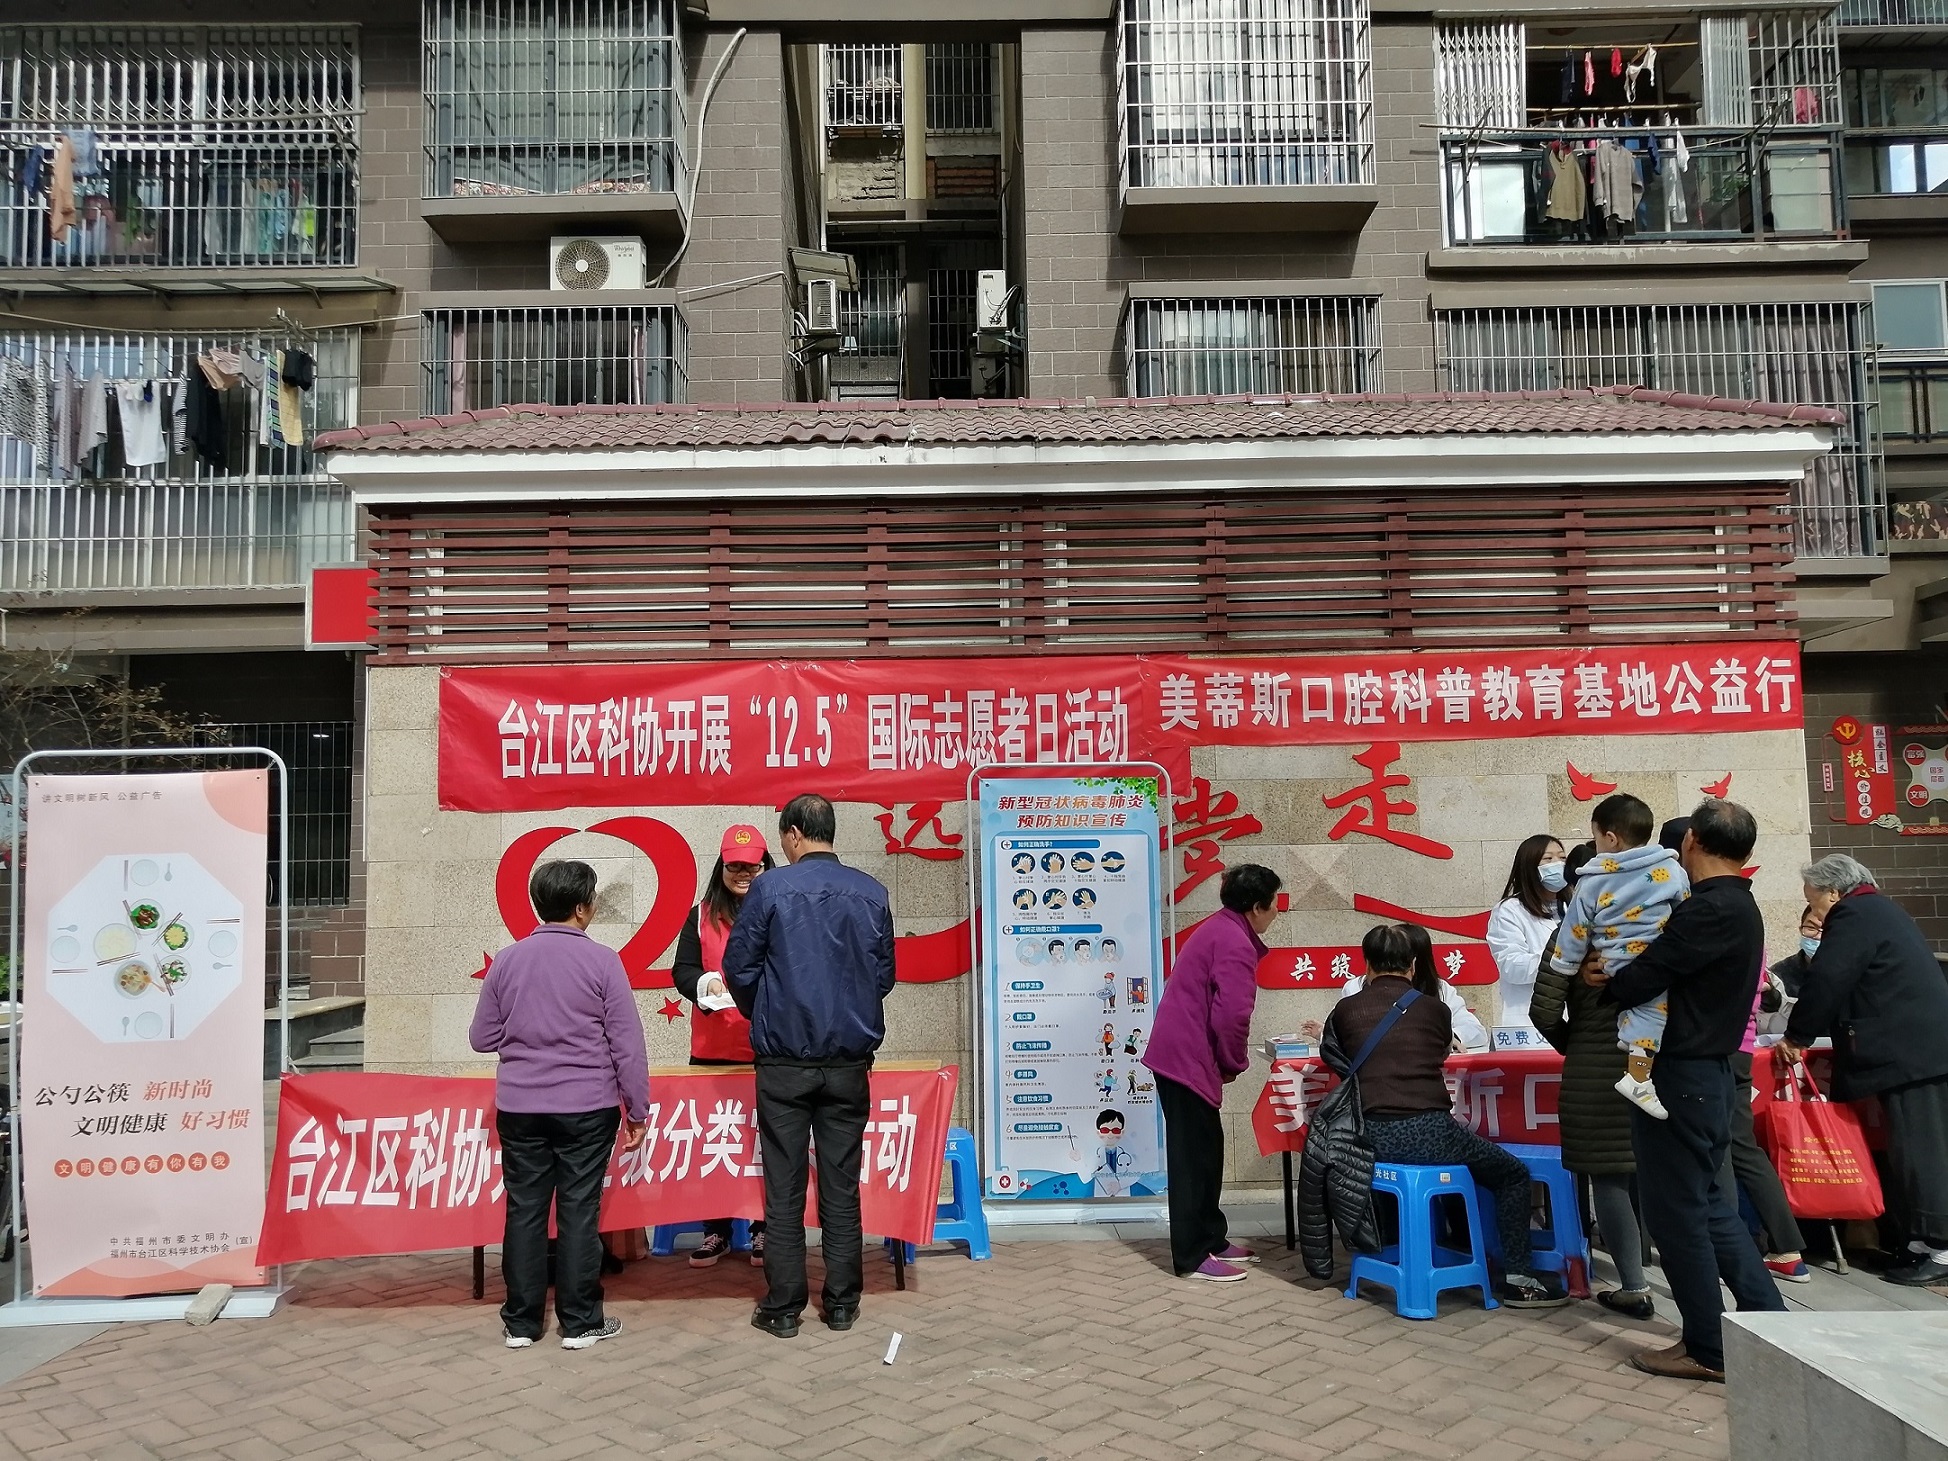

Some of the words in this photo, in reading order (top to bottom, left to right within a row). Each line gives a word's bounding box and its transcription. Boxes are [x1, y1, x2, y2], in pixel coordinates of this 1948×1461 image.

[1159, 656, 1796, 731] 美蒂斯口腔科普教育基地公益行
[118, 791, 163, 801] 公益广告
[998, 795, 1144, 810] 新型冠状病毒肺炎
[1910, 790, 1928, 799] 文明
[1016, 813, 1127, 828] 预防知识宣传
[1290, 950, 1466, 981] 共筑梦
[34, 1082, 131, 1107] 公勺公筷
[143, 1079, 213, 1102] 新时尚
[1267, 1062, 1563, 1137] 美斯口
[71, 1112, 168, 1138] 文明健康
[179, 1108, 251, 1132] 好习惯
[57, 1153, 228, 1176] 文明健康有你有我
[110, 1232, 229, 1246] 中共福州市委文明办
[110, 1243, 230, 1259] 福州市台江区科学技术协会
